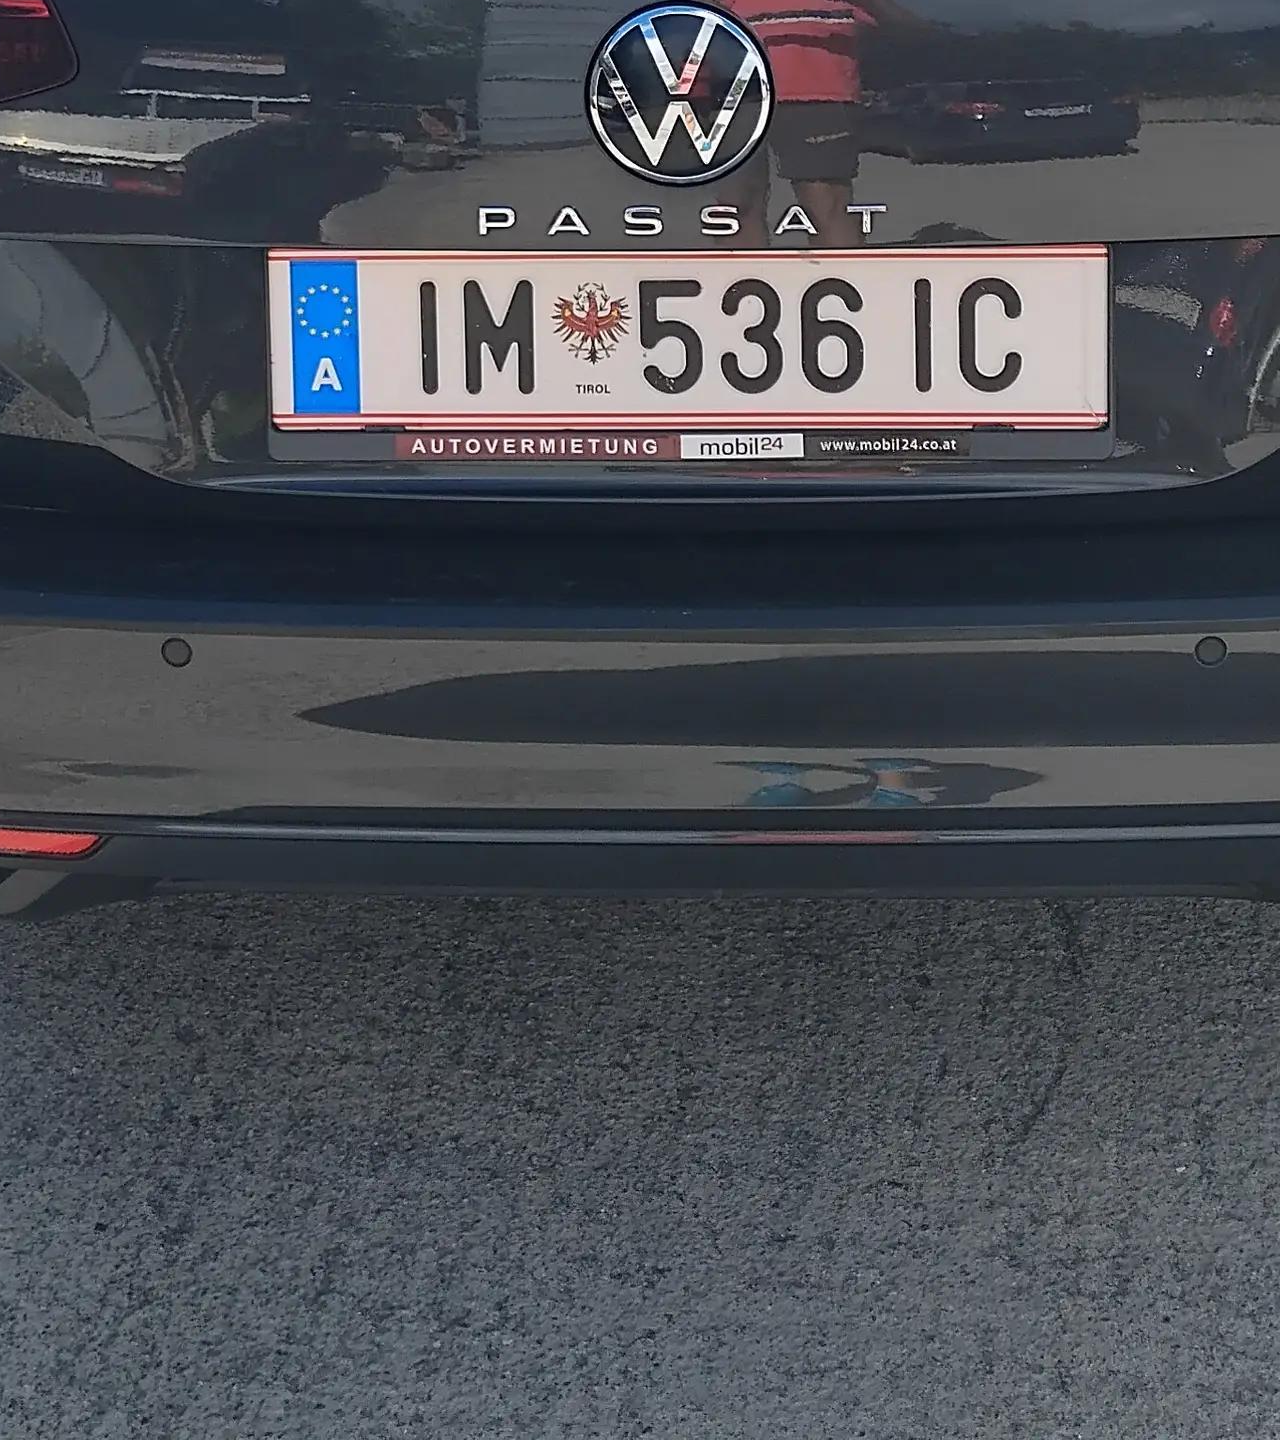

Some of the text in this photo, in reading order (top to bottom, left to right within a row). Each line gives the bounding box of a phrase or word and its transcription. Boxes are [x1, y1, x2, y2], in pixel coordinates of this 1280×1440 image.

[477, 204, 888, 236] PASSAT
[310, 277, 1023, 396] A IM 536 IC
[575, 383, 611, 394] TIROL
[411, 436, 957, 456] AUTOVERMIETUNG mobil24 www.mobil24.co.at
